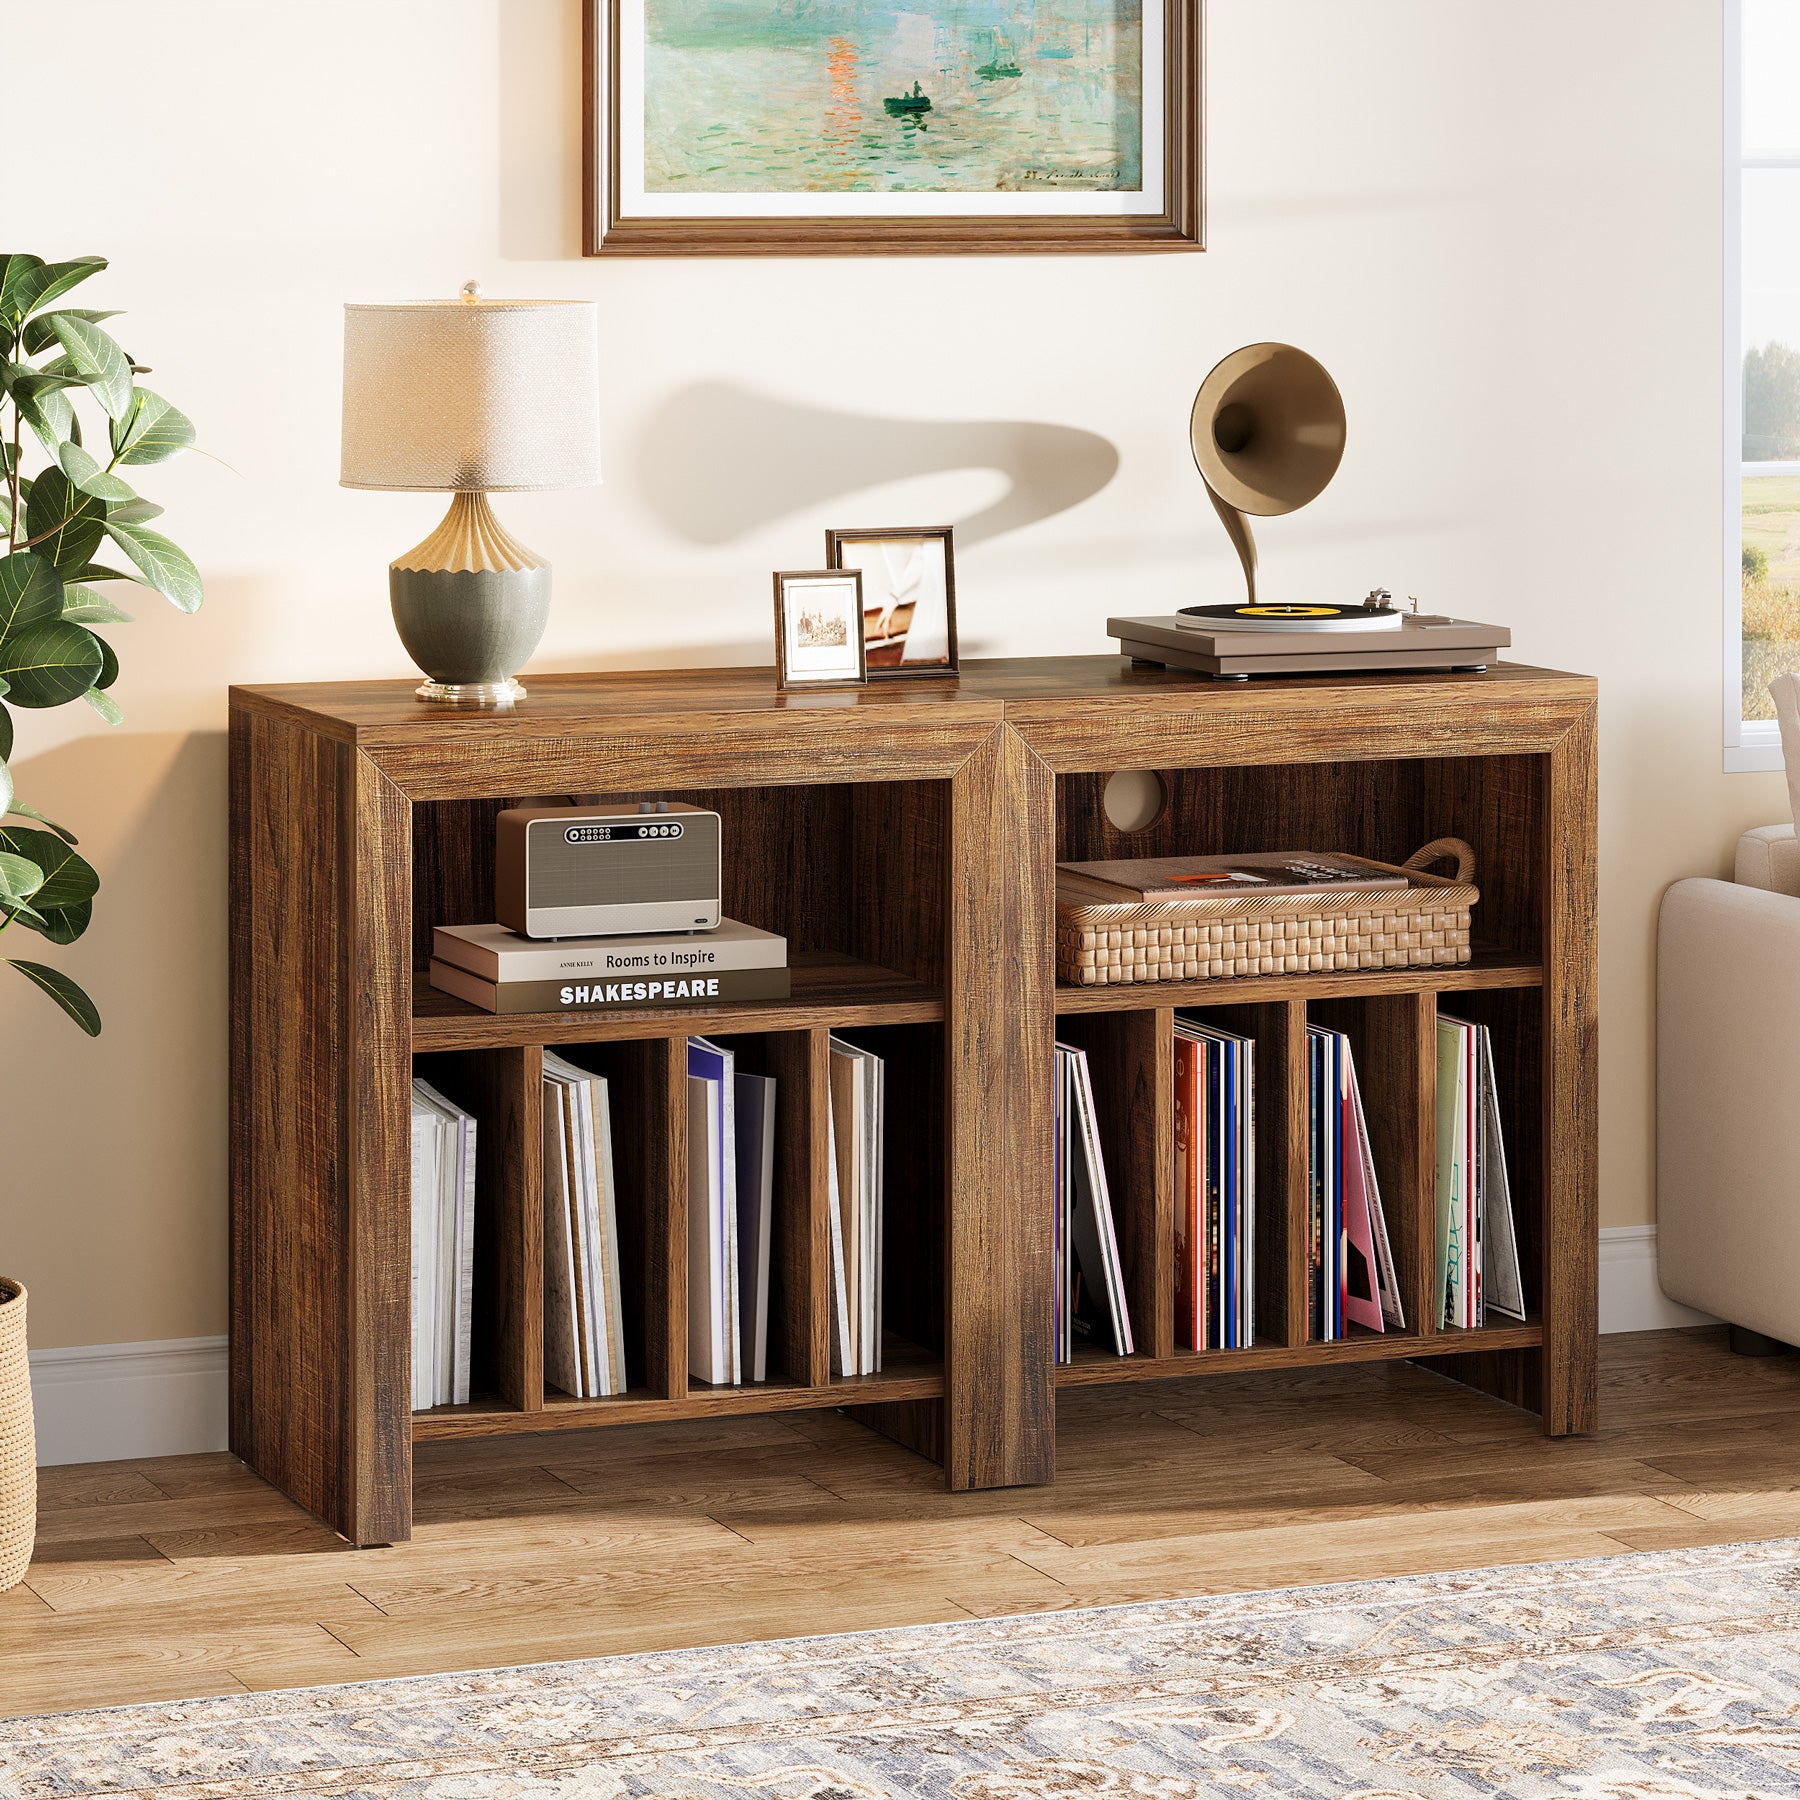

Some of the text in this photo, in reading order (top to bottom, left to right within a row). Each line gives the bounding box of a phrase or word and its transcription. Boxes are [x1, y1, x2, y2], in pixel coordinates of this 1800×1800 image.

[606, 949, 715, 968] Rooms to Inspire
[560, 978, 719, 1004] SHAKESPEARE
